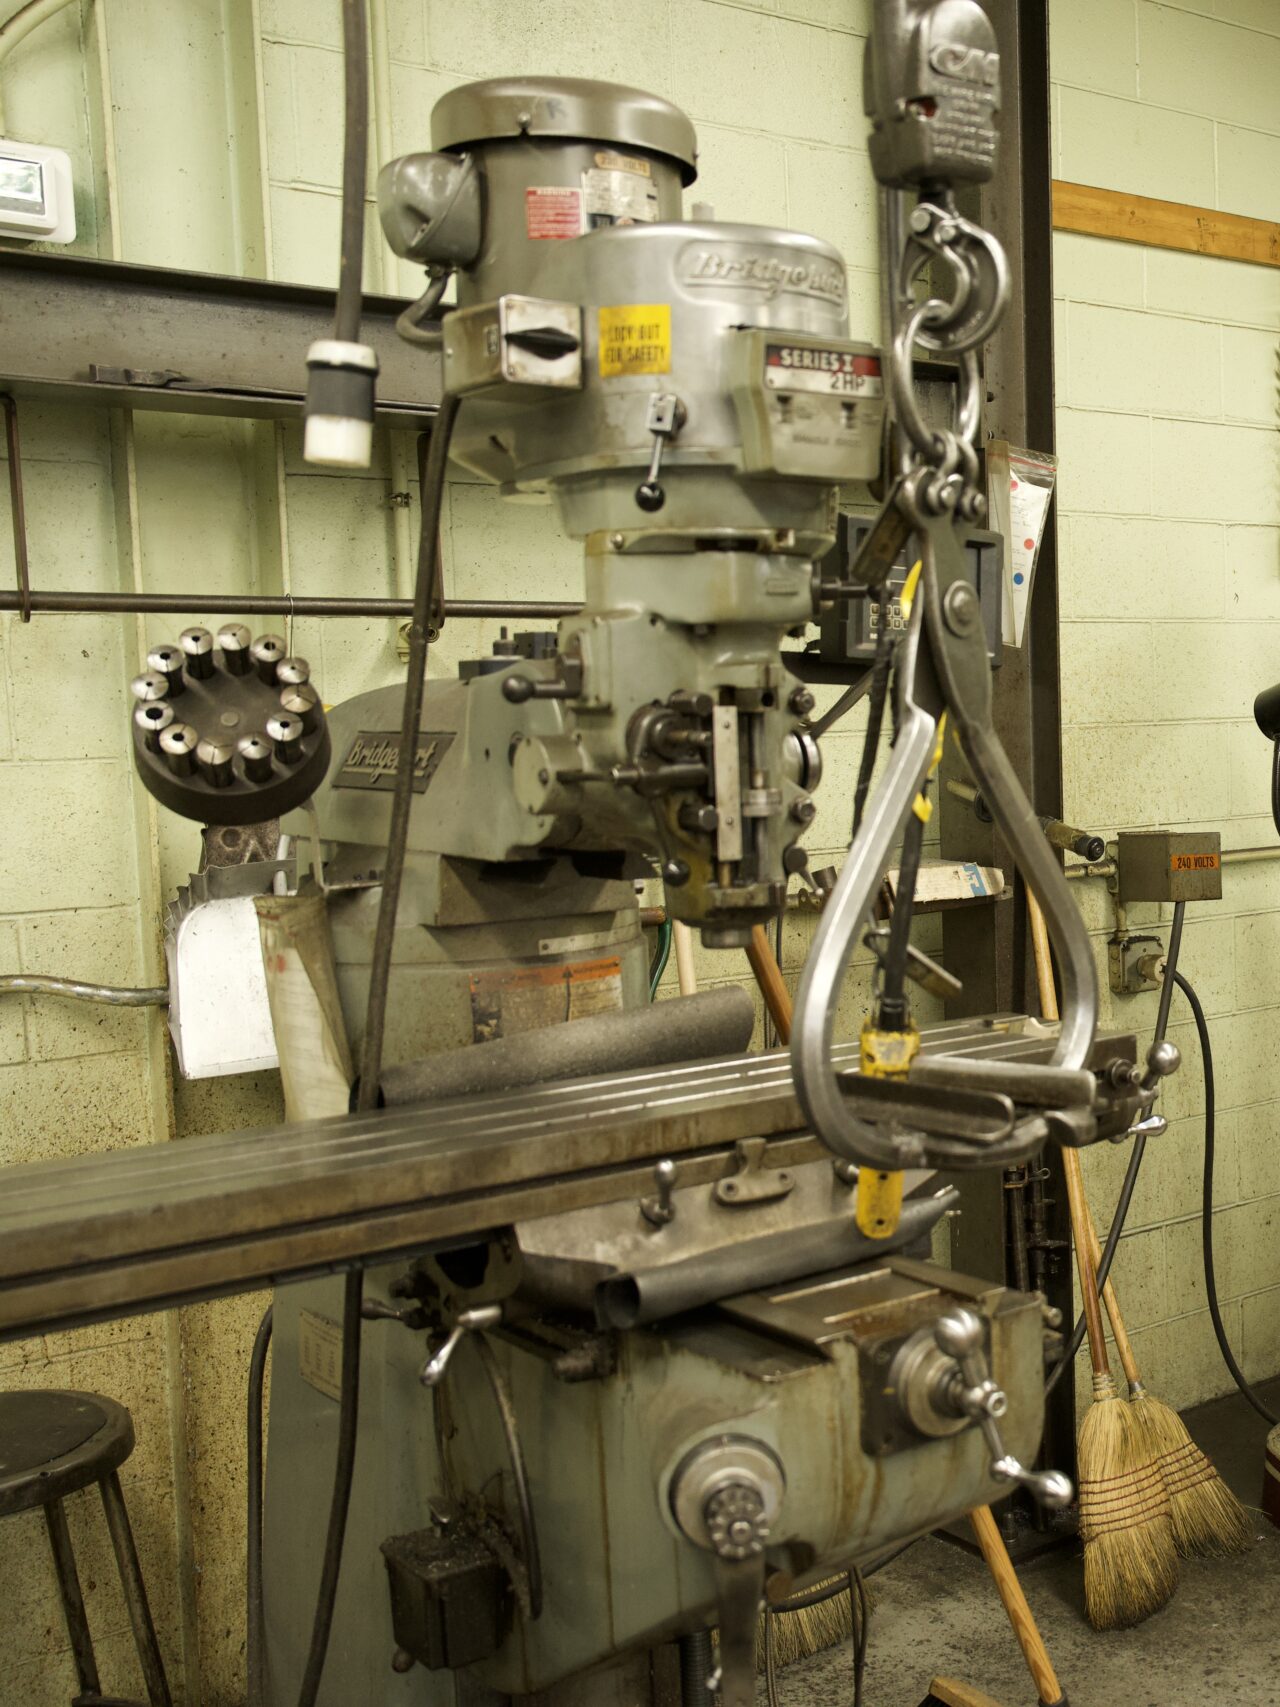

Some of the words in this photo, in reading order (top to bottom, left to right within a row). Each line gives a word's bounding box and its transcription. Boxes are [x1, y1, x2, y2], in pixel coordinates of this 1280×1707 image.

[639, 323, 661, 341] OUT
[605, 346, 623, 364] FOR
[626, 344, 666, 362] SAFETY
[780, 348, 841, 372] SERIES
[346, 738, 438, 784] Bridgert
[1177, 857, 1191, 869] 240
[1194, 856, 1214, 868] VOLTS
